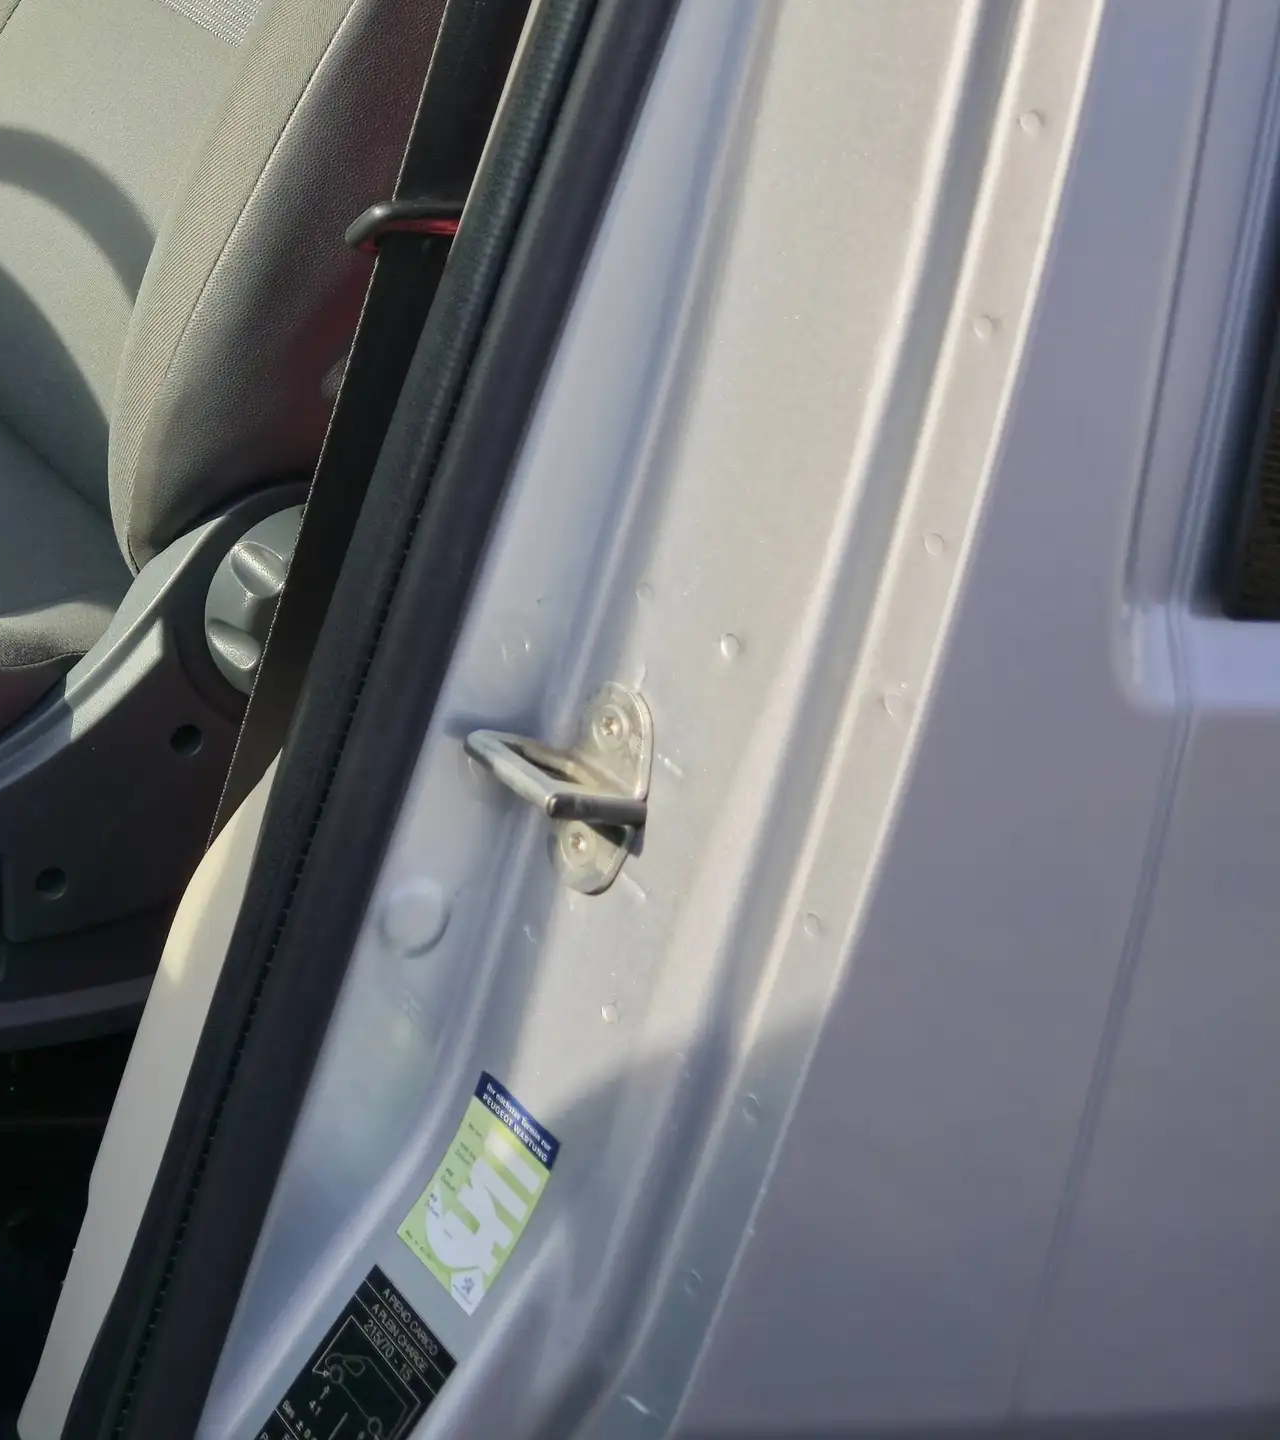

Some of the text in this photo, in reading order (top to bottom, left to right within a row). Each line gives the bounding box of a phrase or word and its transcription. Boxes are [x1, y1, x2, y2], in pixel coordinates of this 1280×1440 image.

[482, 1092, 549, 1163] PEUGEOT WARTUNG
[520, 1116, 541, 1141] Termin
[363, 1320, 395, 1358] 215/70
[400, 1363, 414, 1381] 15
[378, 1310, 400, 1337] PLEIN
[397, 1334, 429, 1373] CHARGE
[388, 1294, 412, 1323] PIENO
[409, 1321, 439, 1356] CARICO
